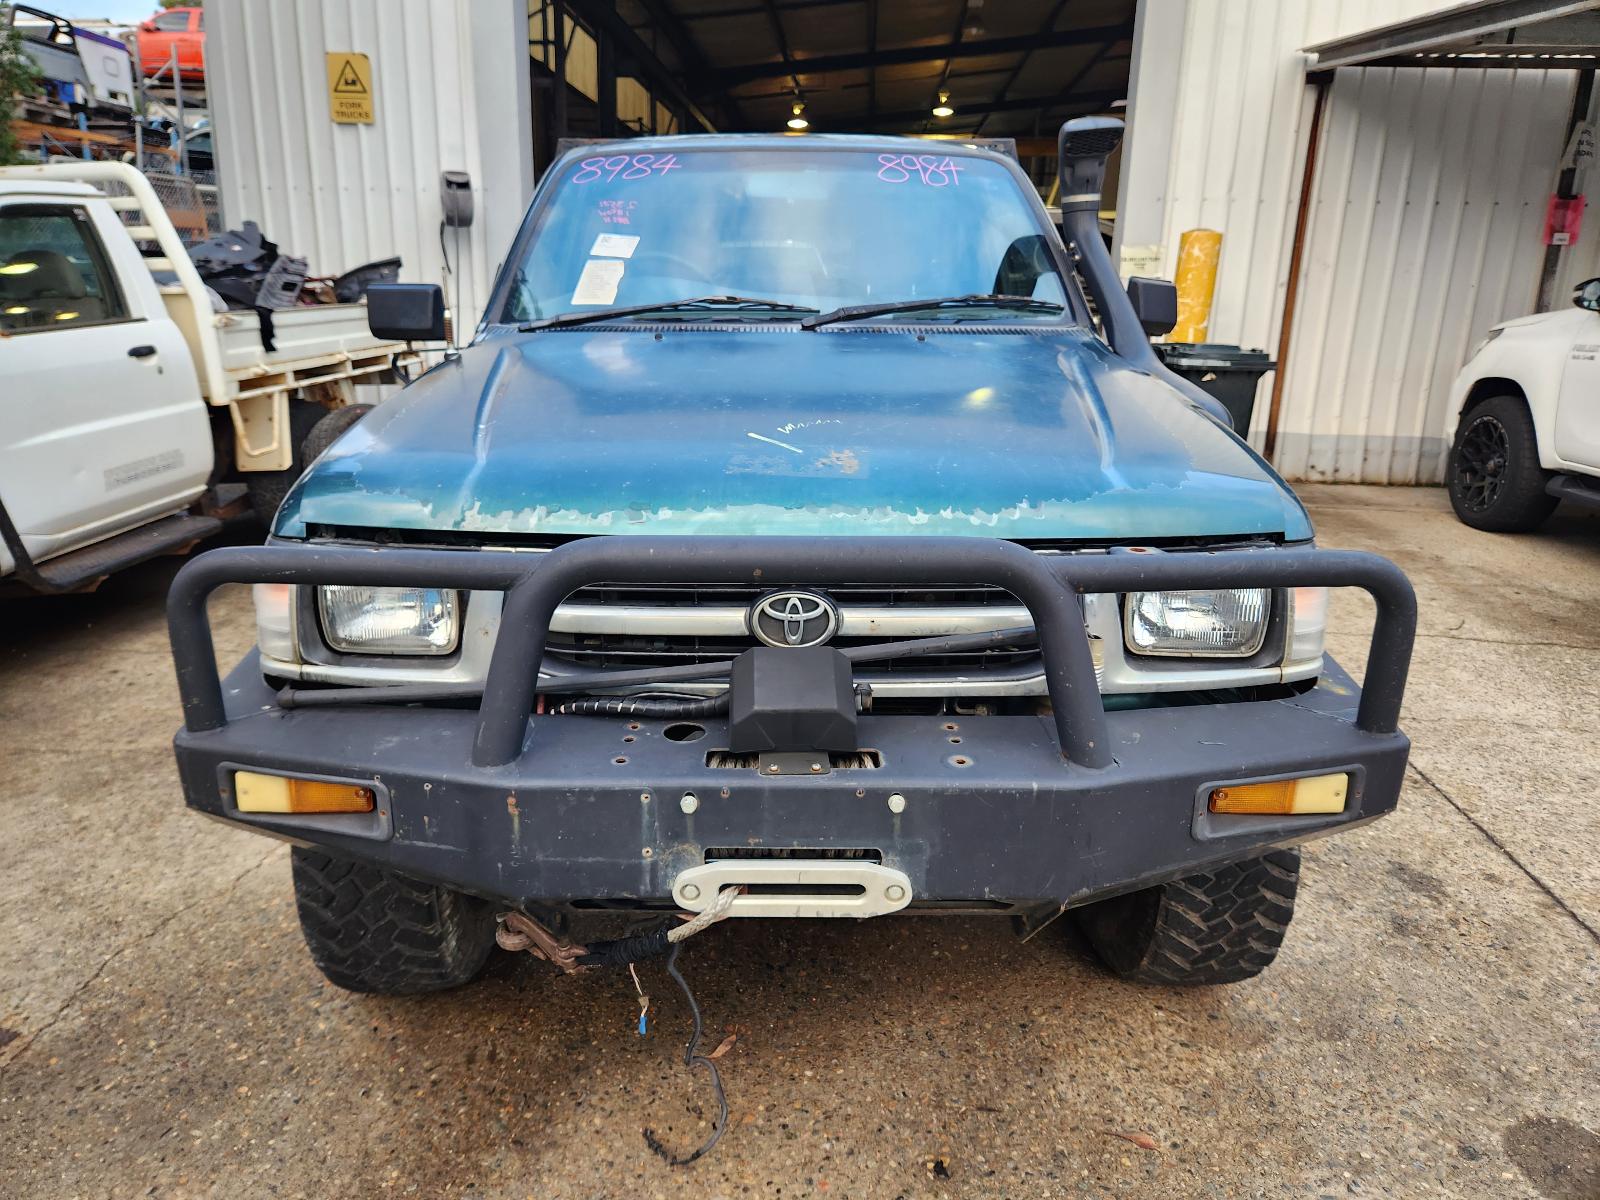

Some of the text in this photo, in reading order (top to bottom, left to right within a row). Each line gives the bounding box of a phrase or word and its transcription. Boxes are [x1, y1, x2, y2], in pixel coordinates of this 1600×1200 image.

[335, 111, 370, 120] TRUCKS
[339, 102, 363, 110] FORK
[572, 154, 682, 184] 8984
[877, 154, 964, 186] 8984
